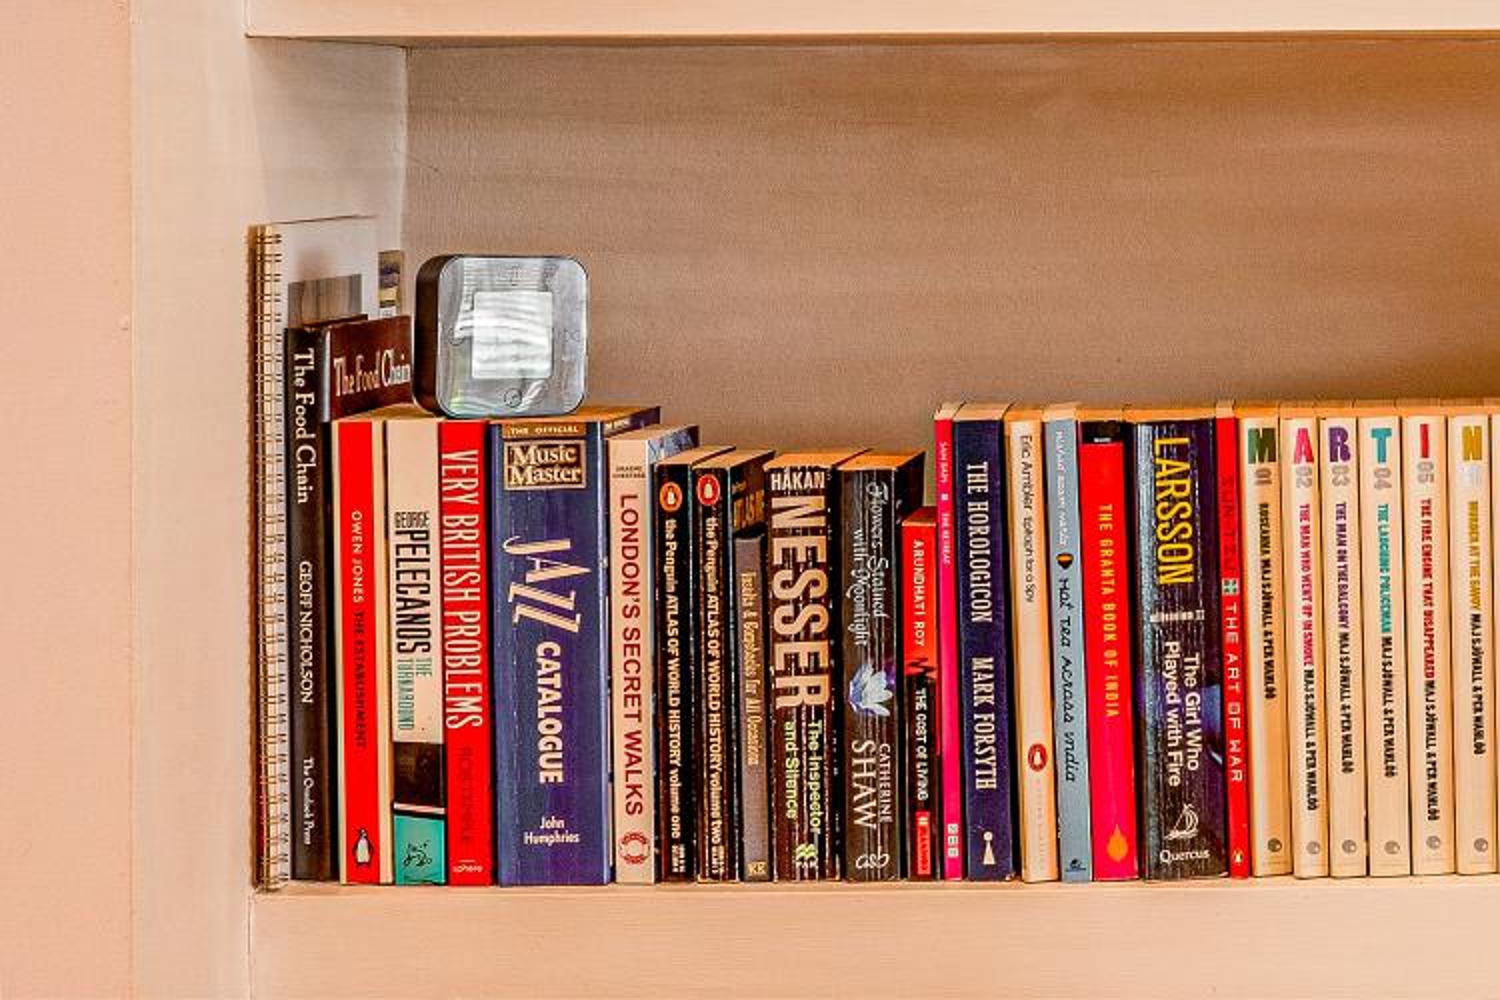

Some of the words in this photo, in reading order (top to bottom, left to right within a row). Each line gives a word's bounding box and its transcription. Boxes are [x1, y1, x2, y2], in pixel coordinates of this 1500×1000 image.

[294, 348, 314, 386] The
[294, 393, 316, 440] Food
[295, 444, 317, 504] Chain
[442, 450, 480, 504] VERY
[507, 444, 578, 464] Music
[507, 468, 581, 482] Master
[966, 462, 988, 494] THE
[352, 511, 362, 554] OWEN
[1154, 438, 1194, 584] LARSSON
[442, 515, 481, 601] BRITISH
[621, 494, 642, 618] LONDON'S
[912, 540, 924, 615] ARUNDHATI
[967, 501, 992, 622] HOROLOGICON
[301, 561, 314, 609] GEOFF
[352, 558, 363, 602] JONES
[395, 530, 432, 652] PELECANOS
[503, 536, 592, 633] JAZZ
[771, 495, 829, 709] NESSER
[913, 621, 924, 646] ROY
[1226, 604, 1238, 644] THE
[301, 611, 314, 703] NICHOLSON
[443, 611, 483, 729] PROBLEMS
[622, 628, 642, 722] SECRET
[1162, 642, 1180, 704] Played
[1184, 652, 1200, 688] The
[1228, 654, 1240, 698] ART
[916, 688, 928, 710] THE
[972, 657, 994, 706] MARK
[537, 642, 562, 784] CATALOGUE
[916, 714, 928, 742] COST
[1166, 708, 1182, 746] with
[1185, 692, 1201, 724] Girl
[1228, 702, 1240, 728] OF
[786, 722, 800, 750] and
[808, 720, 822, 747] The
[916, 746, 928, 758] OF
[973, 713, 996, 790] FORSYTH
[1186, 728, 1202, 770] Who
[625, 730, 643, 816] WALKS
[879, 743, 892, 822] CATHERINE
[916, 762, 928, 801] LIVING
[1168, 752, 1183, 787] Fire
[1230, 740, 1242, 782] WAR
[786, 757, 800, 818] Silence
[808, 753, 824, 834] Inspector
[851, 740, 877, 830] SHAW
[1160, 850, 1209, 862] Quercus
